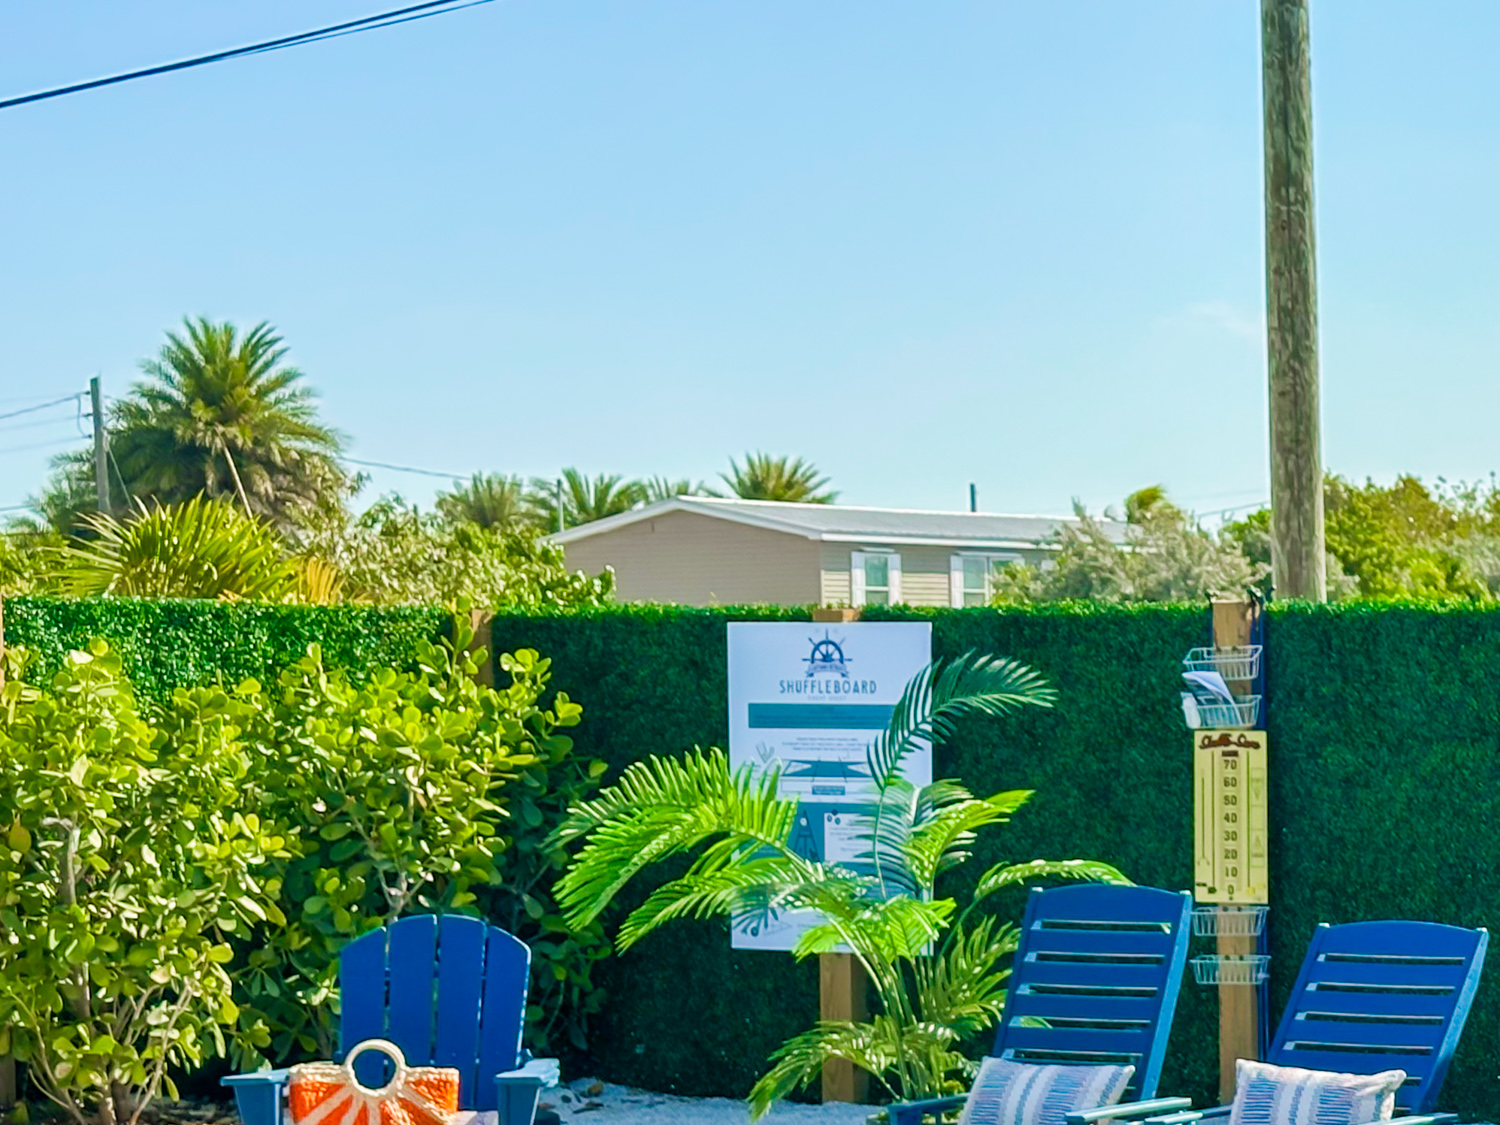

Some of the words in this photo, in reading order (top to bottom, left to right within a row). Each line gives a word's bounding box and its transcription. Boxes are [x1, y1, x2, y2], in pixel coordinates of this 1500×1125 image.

[779, 679, 877, 694] SHUFFLEBOARD
[1223, 759, 1238, 771] 70
[1223, 776, 1238, 788] 60
[1223, 794, 1238, 806] 50
[1223, 812, 1238, 824] 40
[1223, 830, 1238, 842] 30
[1224, 848, 1238, 860] 20
[1225, 866, 1238, 878] 10
